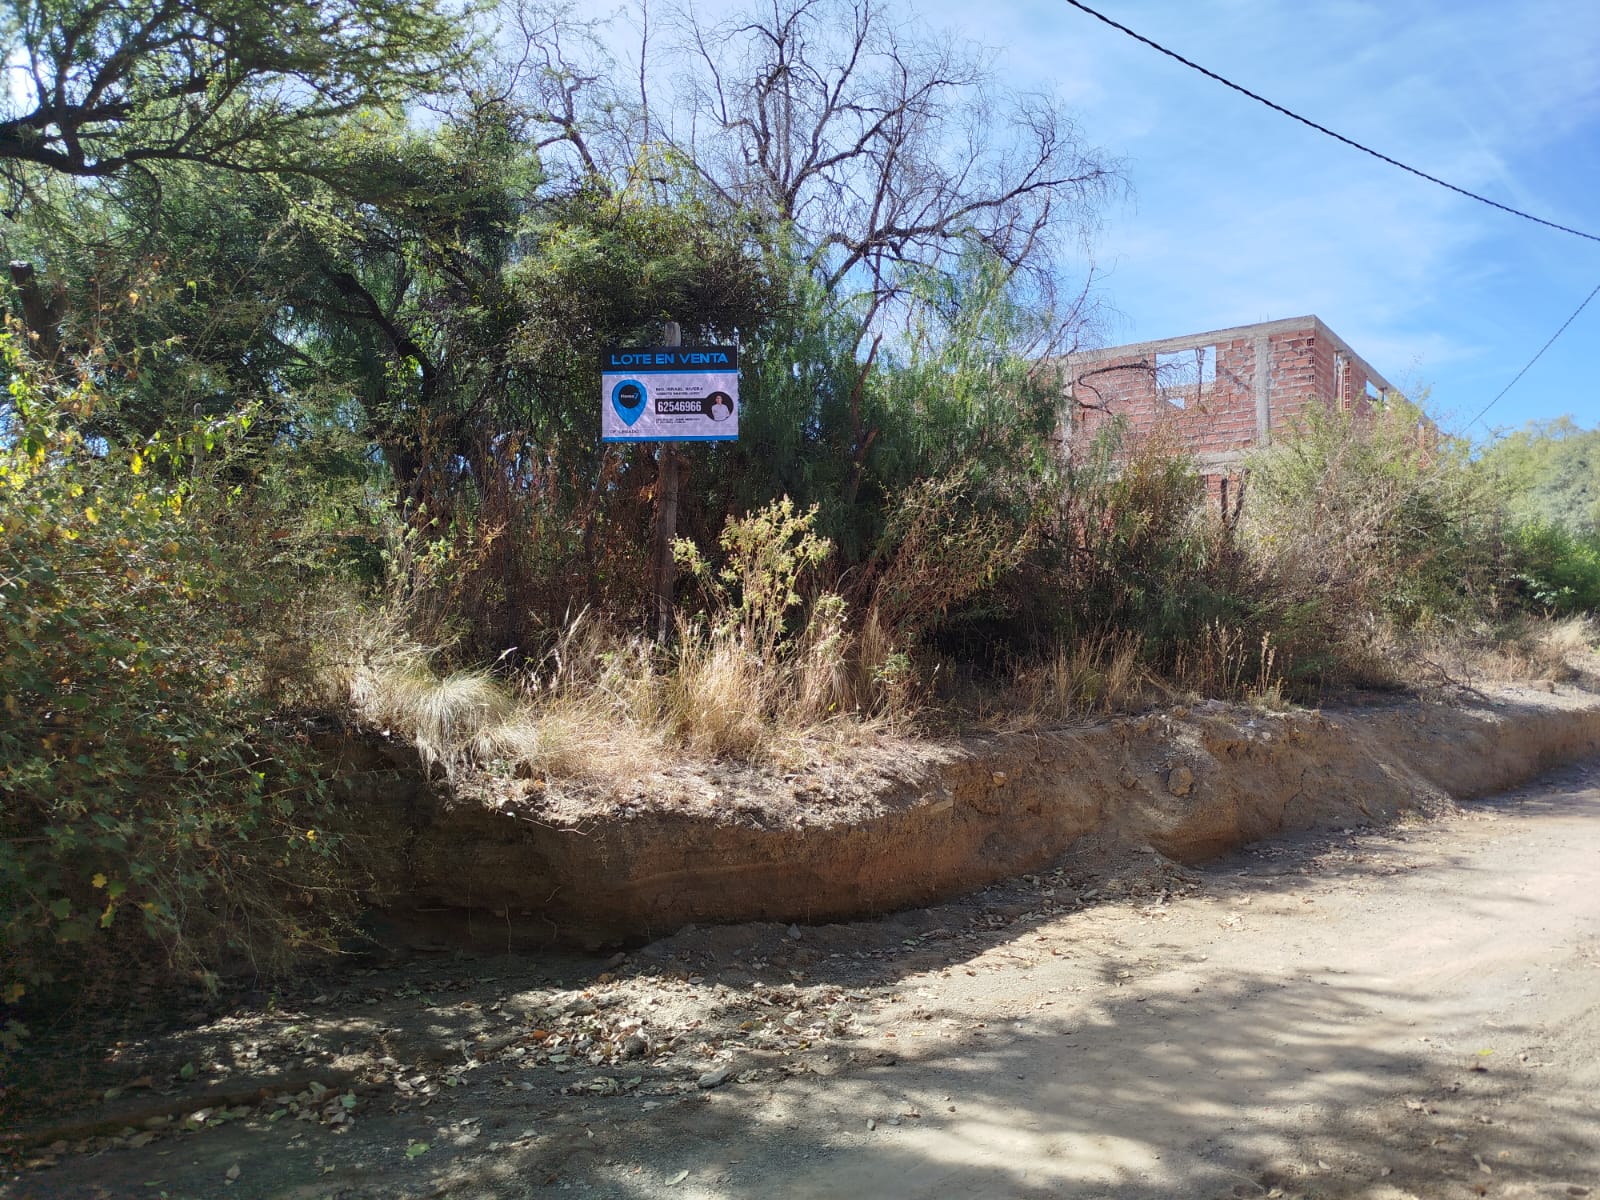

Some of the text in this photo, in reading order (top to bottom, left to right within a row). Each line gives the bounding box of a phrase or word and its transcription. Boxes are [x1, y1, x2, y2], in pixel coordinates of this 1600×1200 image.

[611, 352, 729, 365] LOTE EN VENTA
[657, 400, 702, 412] 62546966
